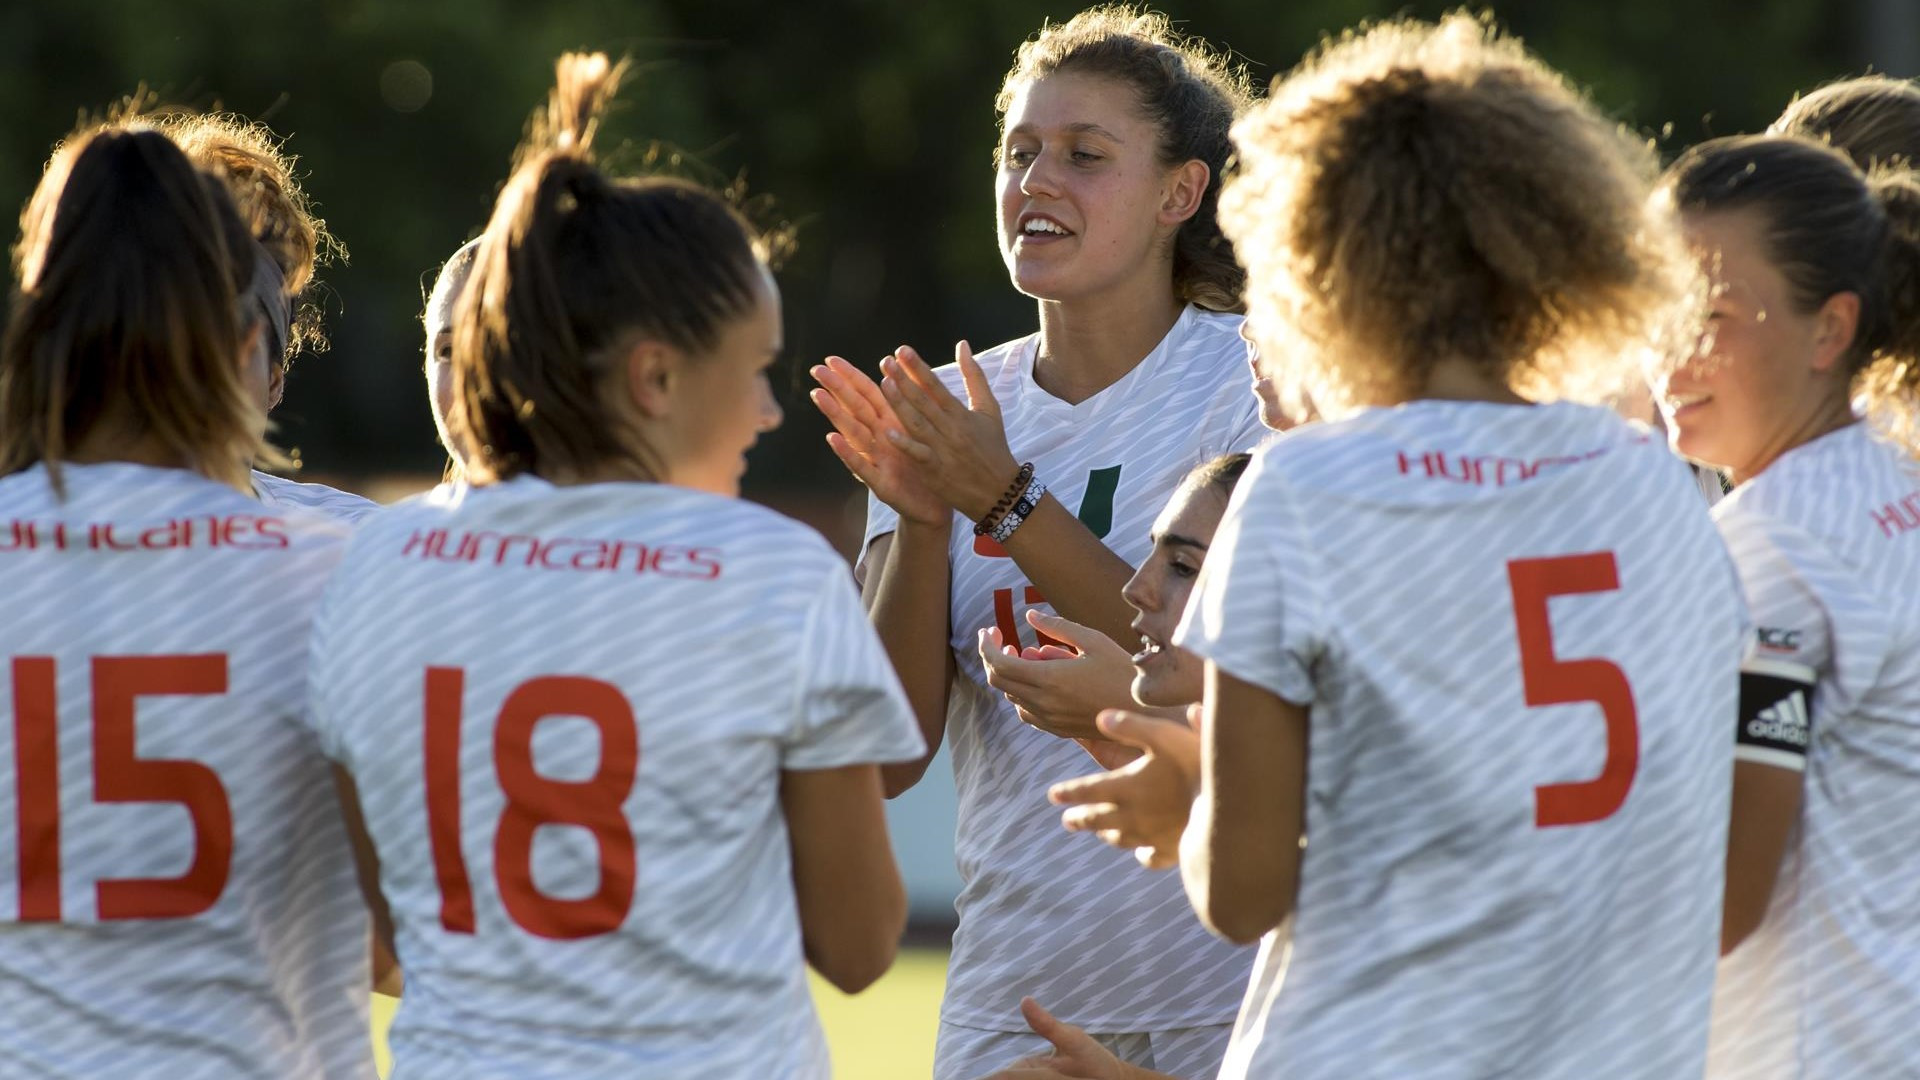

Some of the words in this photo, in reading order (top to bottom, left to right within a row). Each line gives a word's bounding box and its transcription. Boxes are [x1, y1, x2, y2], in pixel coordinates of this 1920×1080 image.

[0, 515, 289, 551] urricanes
[401, 527, 722, 580] Hurricanes
[11, 653, 233, 922] 15
[424, 666, 638, 941] 18
[1506, 550, 1640, 829] 5
